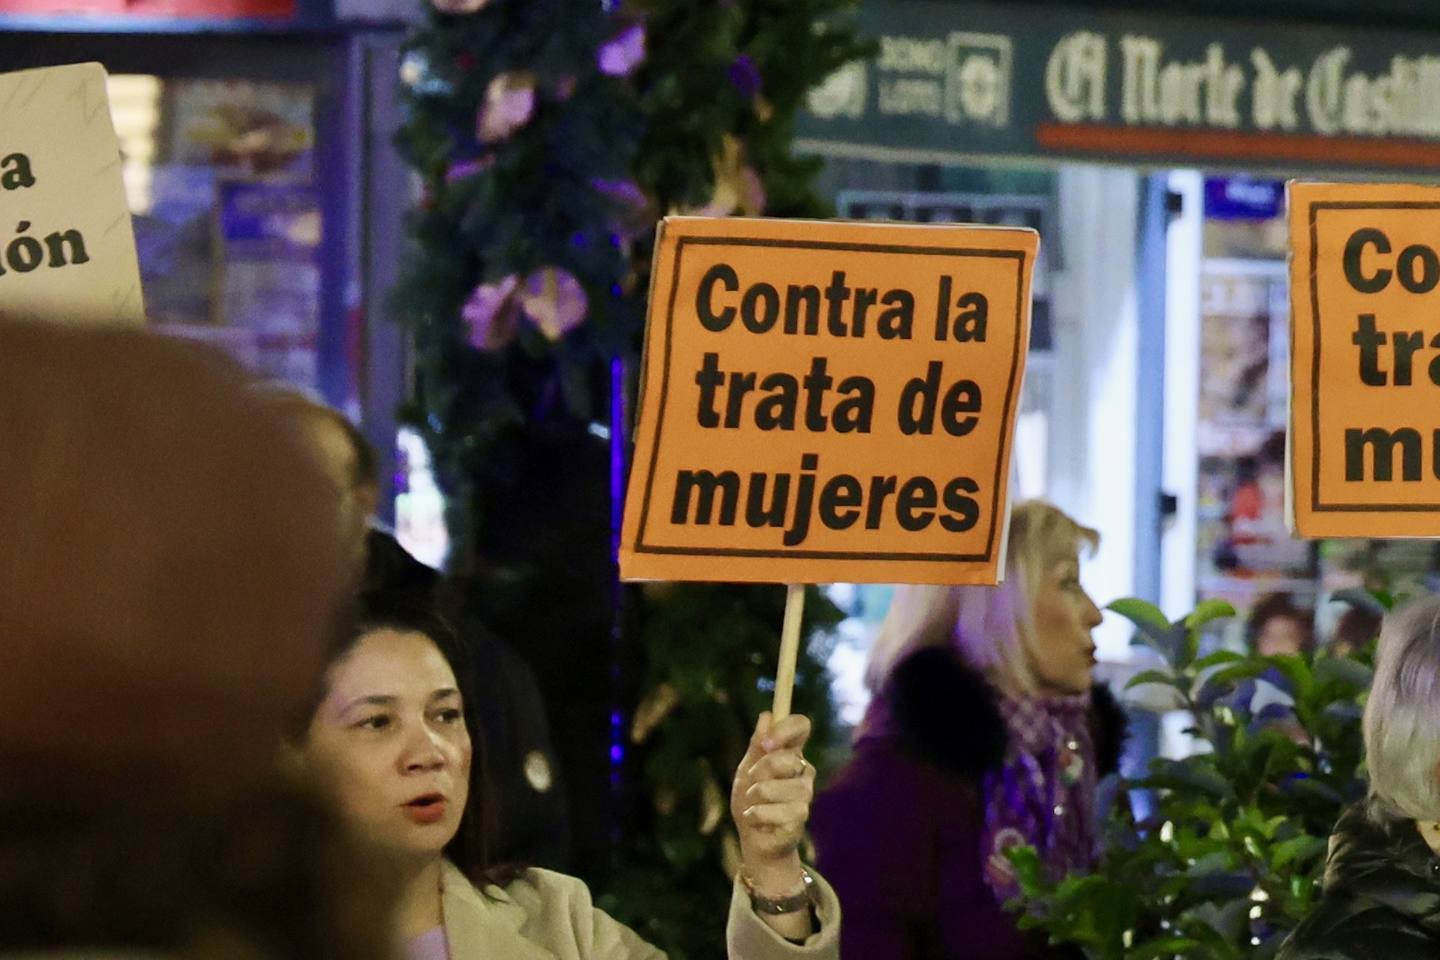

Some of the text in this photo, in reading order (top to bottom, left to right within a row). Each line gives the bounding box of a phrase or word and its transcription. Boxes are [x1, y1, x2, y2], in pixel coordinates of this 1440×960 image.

[696, 263, 989, 343] Contra la
[695, 353, 982, 437] trata de
[670, 453, 981, 547] mujeres
